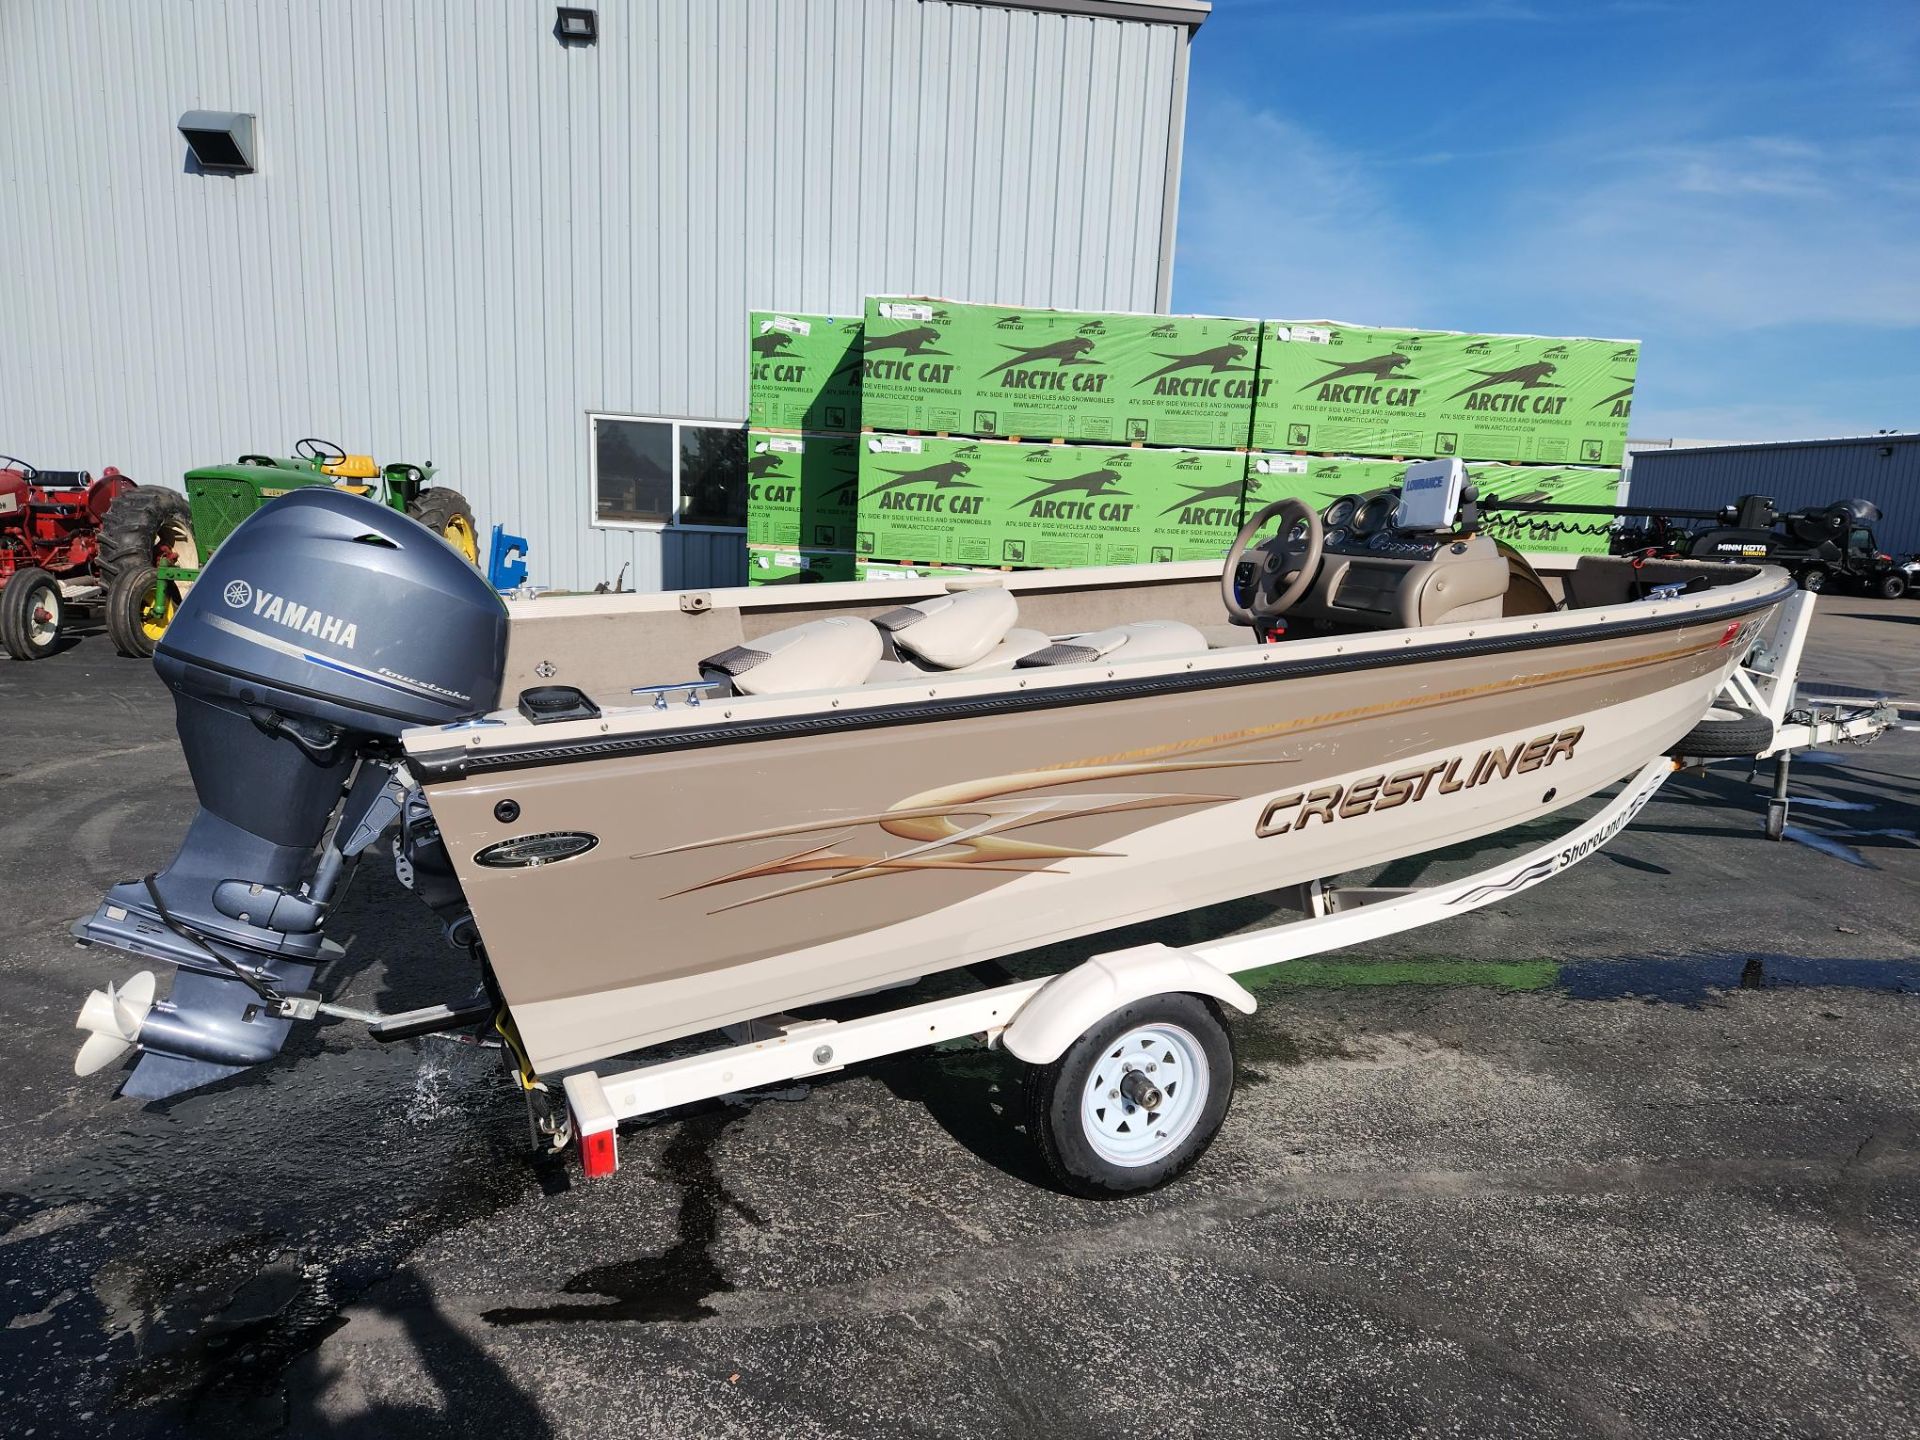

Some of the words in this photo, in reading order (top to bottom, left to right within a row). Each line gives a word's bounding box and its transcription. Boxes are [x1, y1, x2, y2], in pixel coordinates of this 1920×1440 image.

[774, 364, 806, 382] CAT
[918, 363, 954, 383] CAT
[1001, 369, 1068, 390] ARCTIC
[1072, 373, 1108, 392] CAT
[918, 388, 962, 396] SNOWMOBILES
[1153, 377, 1220, 398] ARCTIC
[1316, 384, 1382, 404] ARCTIC
[1386, 388, 1420, 407] CAT
[1464, 392, 1529, 412] ARCTIC
[1532, 396, 1566, 415] CAT
[765, 485, 795, 502] CAT
[1406, 476, 1444, 491] LOWRANCE
[879, 491, 946, 512] ARCTIC
[949, 496, 984, 514] CAT
[1030, 500, 1095, 520] ARCTIC
[1099, 503, 1134, 522] CAT
[251, 588, 357, 649] YAMAHA
[1255, 725, 1584, 838] CRESTLINER
